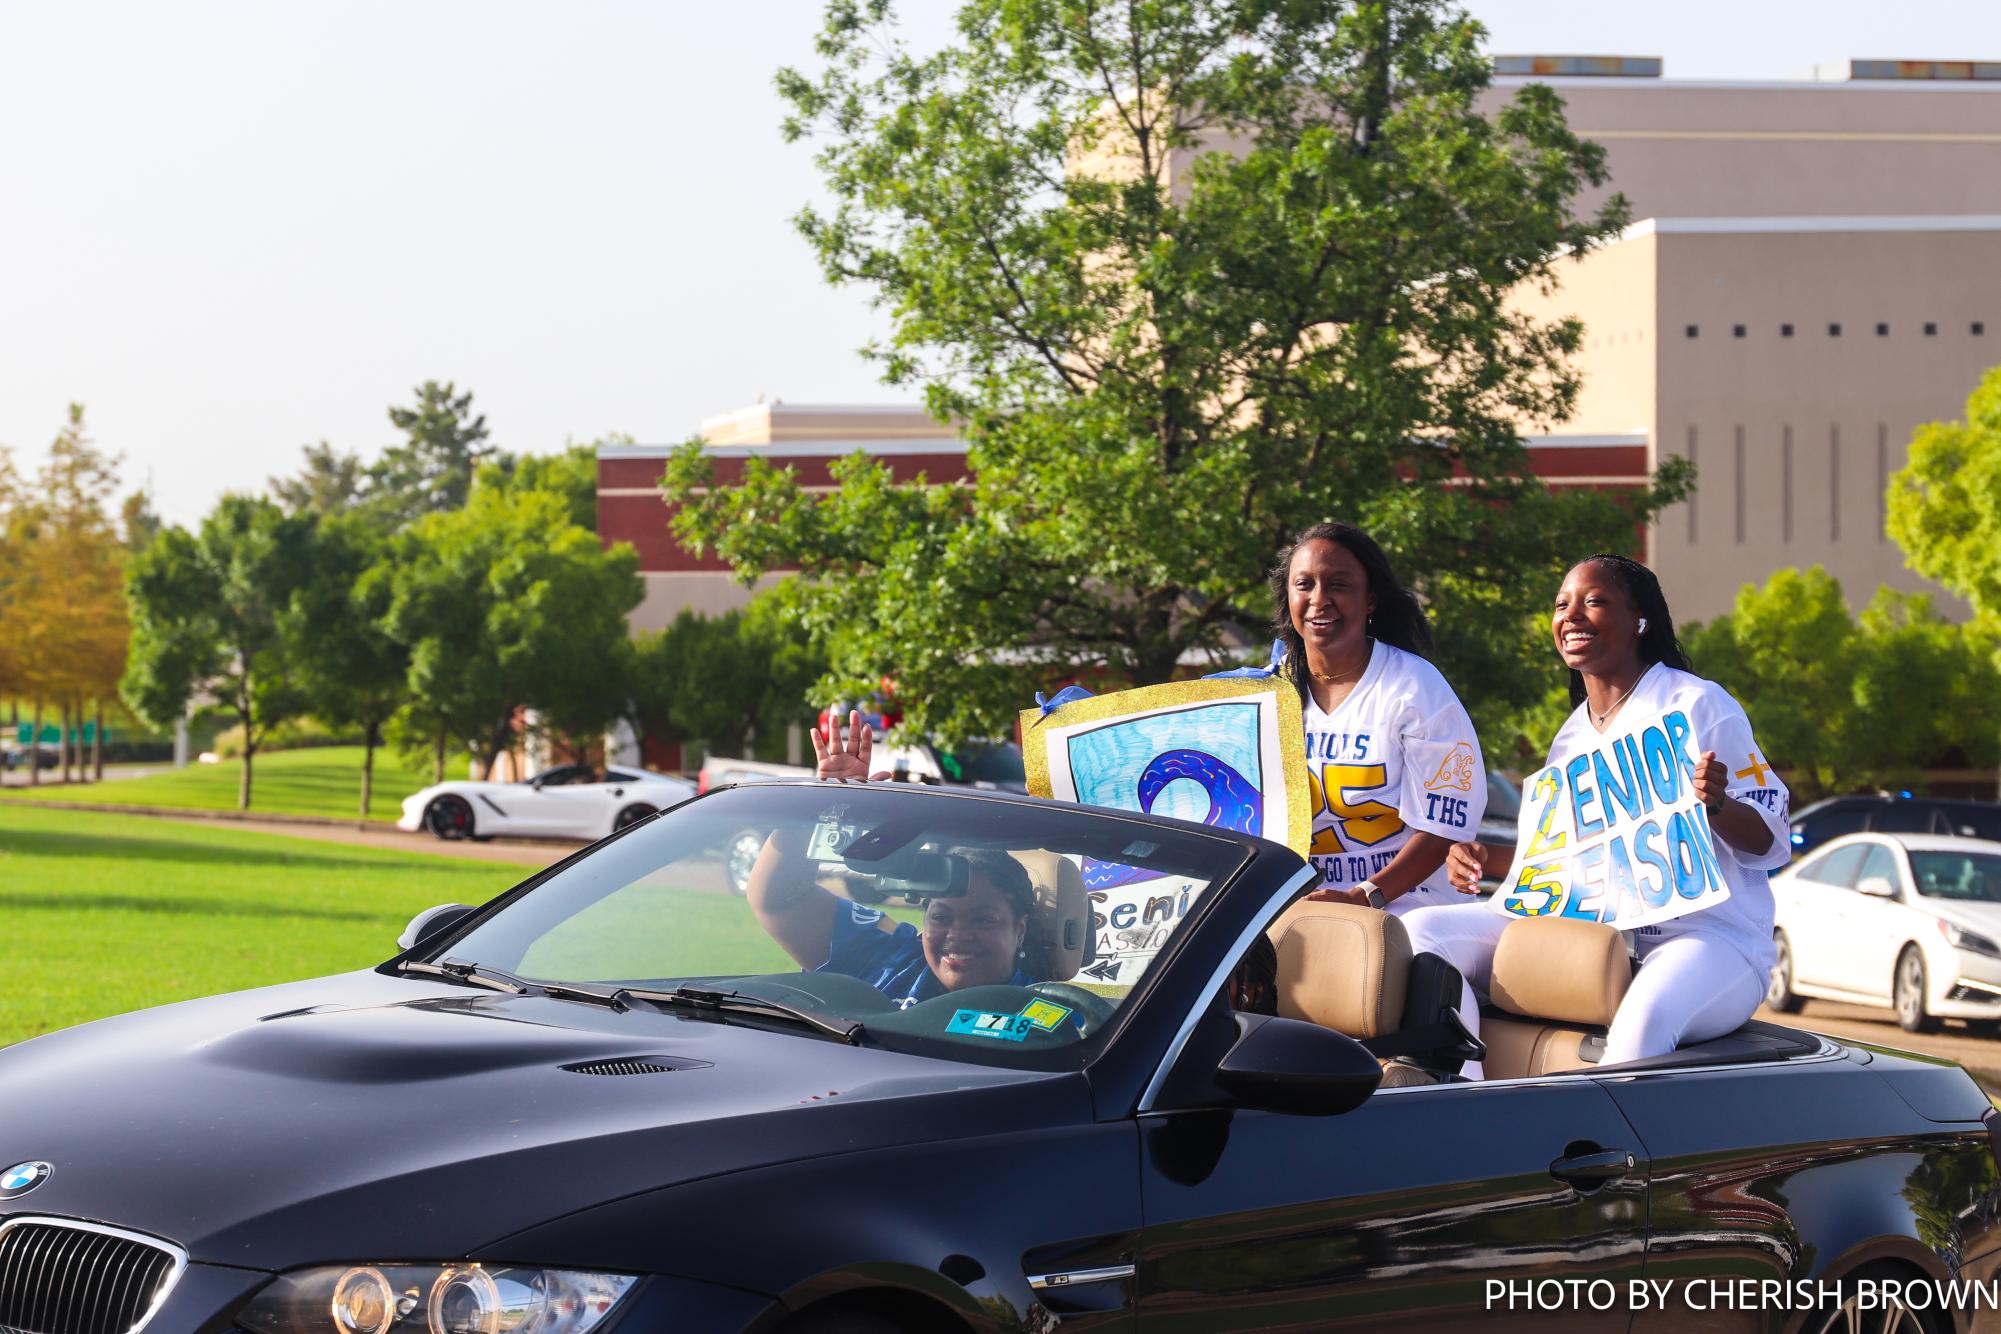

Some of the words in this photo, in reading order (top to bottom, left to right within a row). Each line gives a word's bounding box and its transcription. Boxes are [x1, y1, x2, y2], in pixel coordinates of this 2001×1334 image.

[1426, 792, 1468, 829] THS
[1325, 857, 1343, 883] GO
[1347, 857, 1367, 883] TO
[987, 1014, 1003, 1029] 7
[1003, 1017, 1031, 1034] 18
